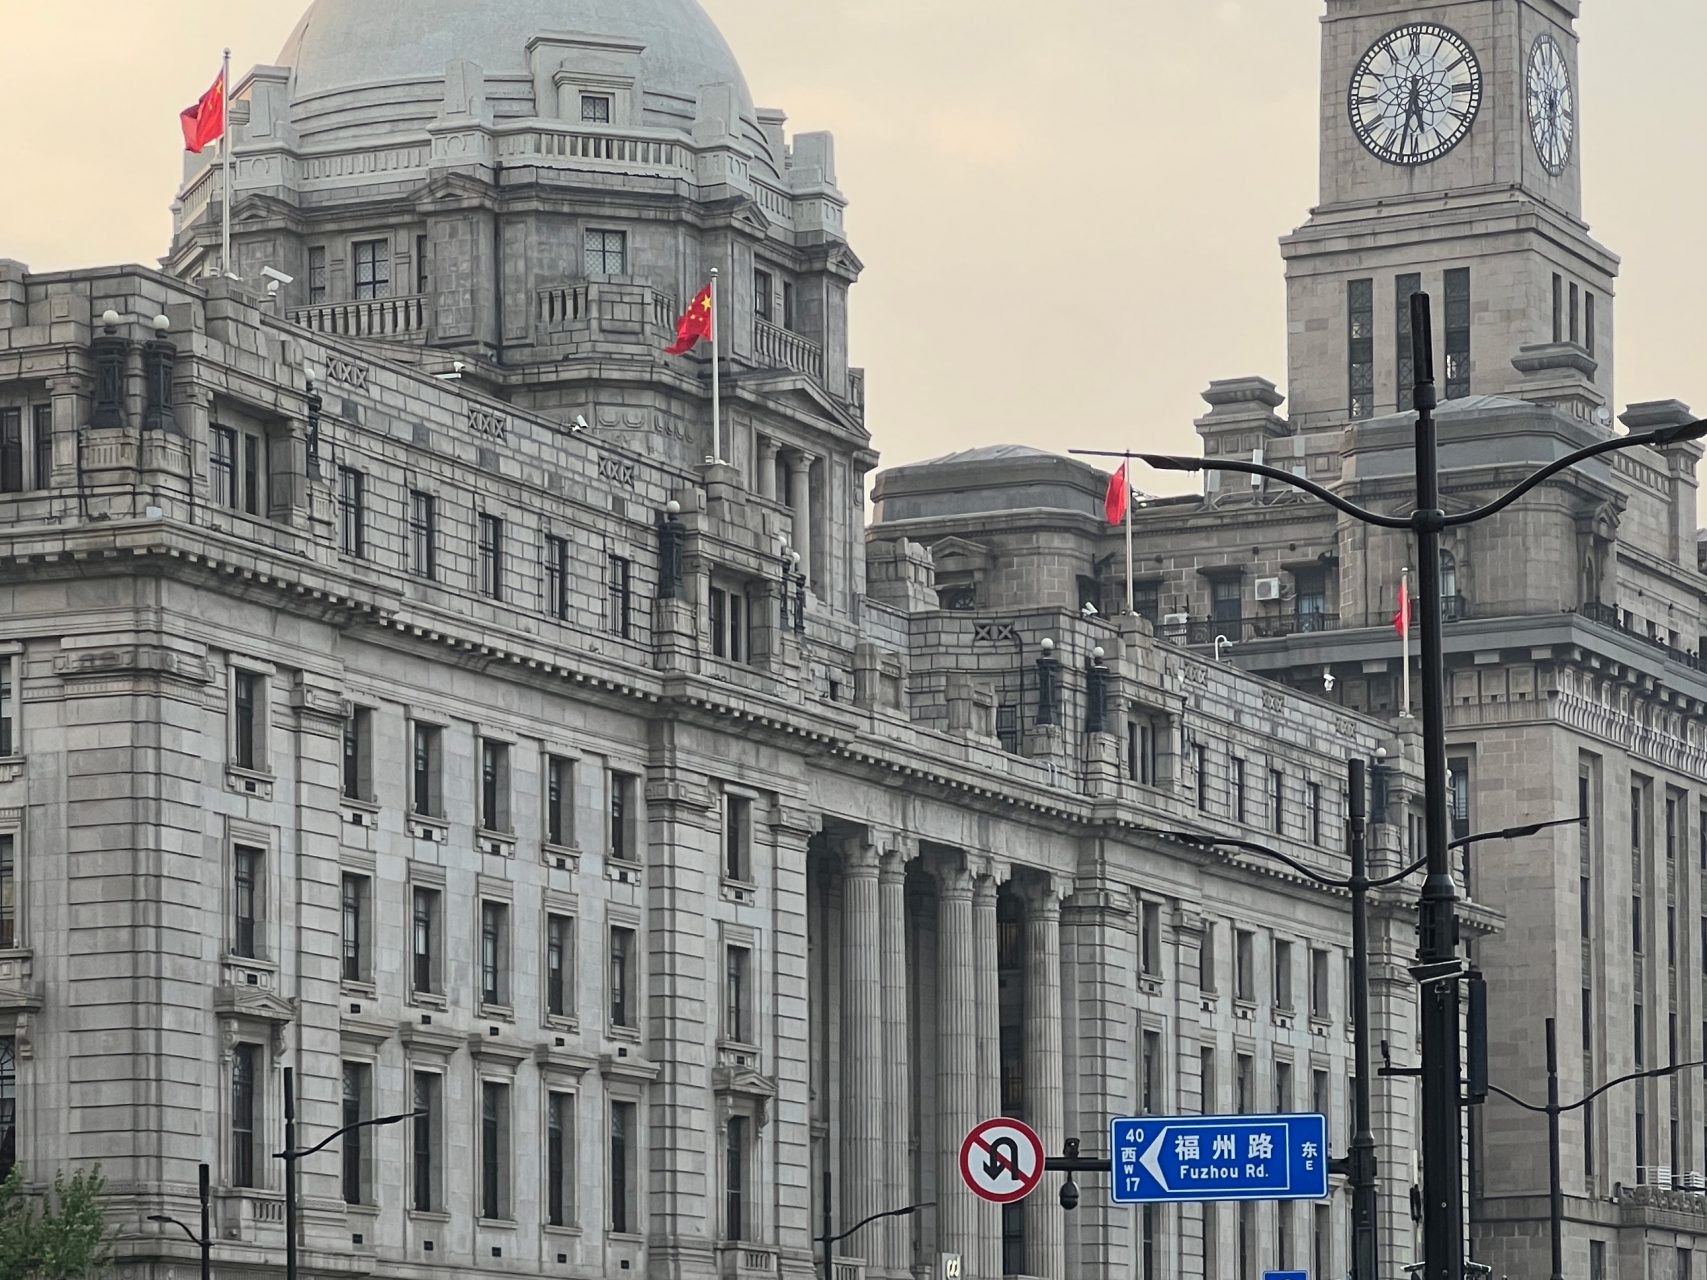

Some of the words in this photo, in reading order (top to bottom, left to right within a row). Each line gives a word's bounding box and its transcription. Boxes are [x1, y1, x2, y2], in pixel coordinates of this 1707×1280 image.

[1126, 1128, 1144, 1142] 40
[1175, 1133, 1273, 1160] 福州路
[1301, 1142, 1318, 1158] 东
[1121, 1147, 1137, 1162] 西
[1124, 1165, 1134, 1174] W
[1180, 1165, 1239, 1179] Fuzhou
[1245, 1163, 1269, 1178] Rd.
[1306, 1160, 1314, 1170] E
[1125, 1178, 1140, 1192] 17
